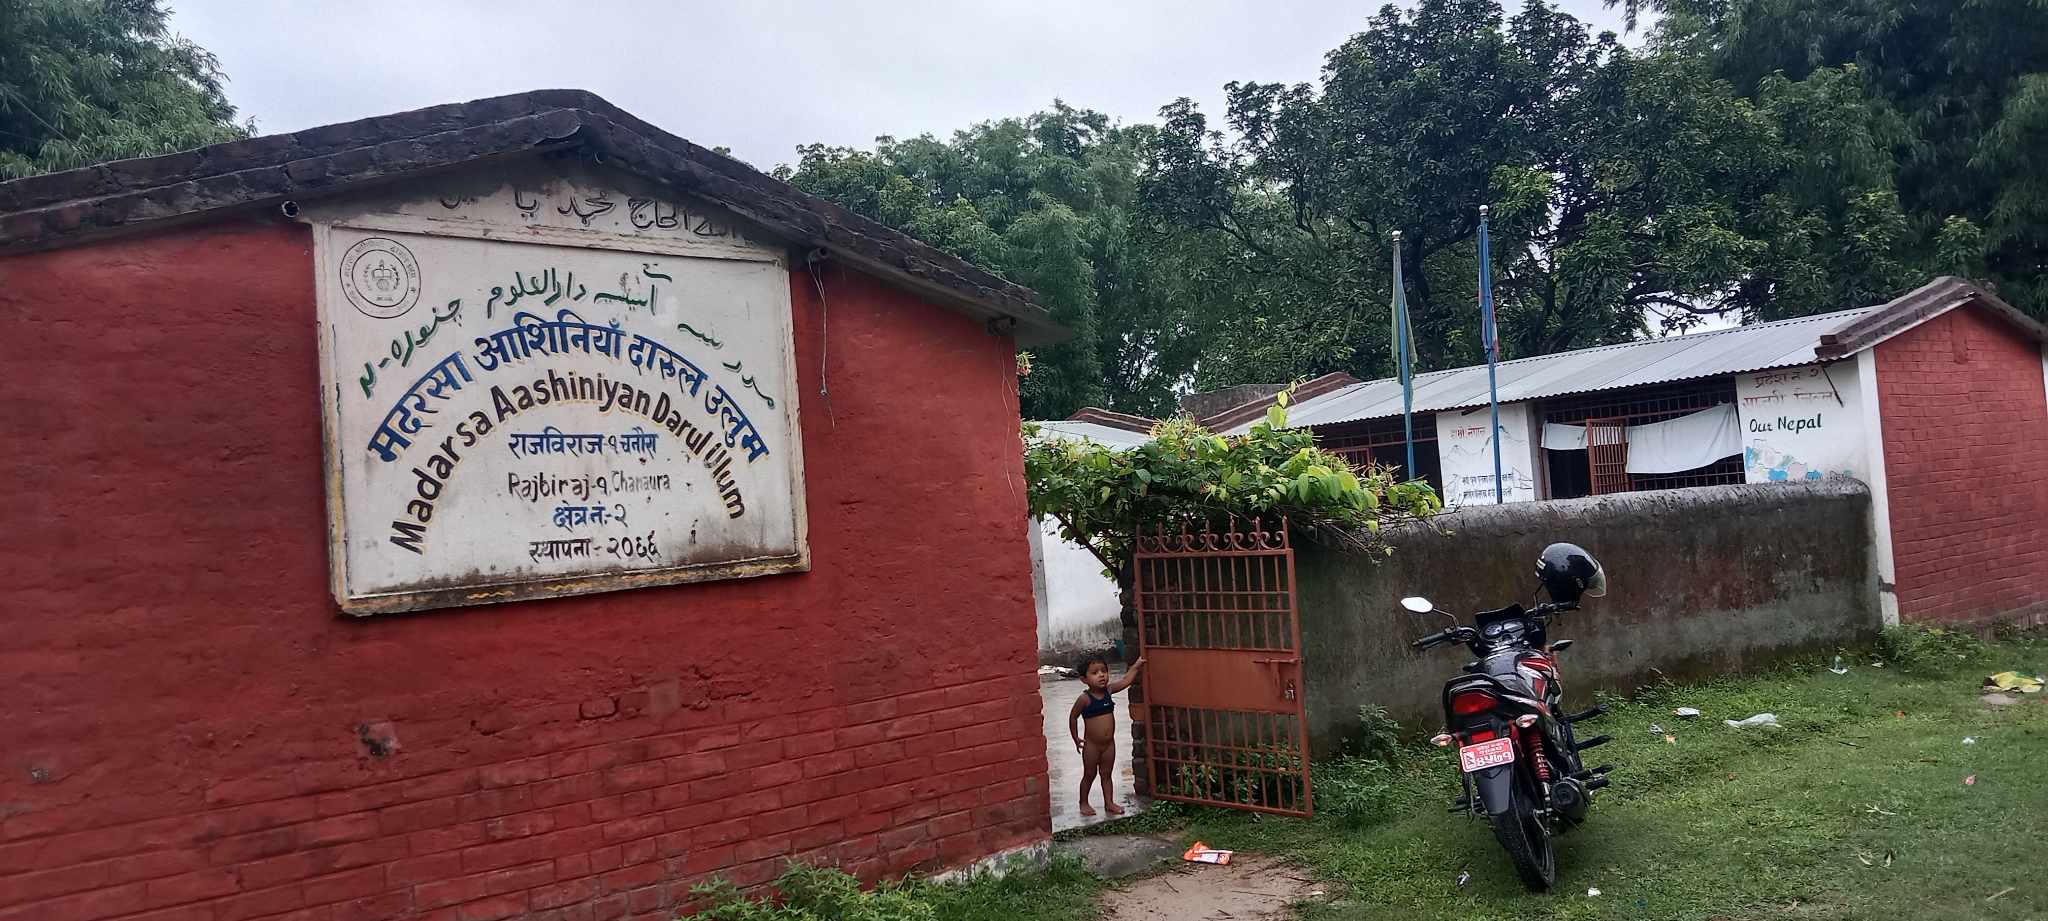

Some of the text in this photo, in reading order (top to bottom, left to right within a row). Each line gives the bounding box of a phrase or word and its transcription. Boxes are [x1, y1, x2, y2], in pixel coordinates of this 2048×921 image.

[367, 351, 474, 462] मदरसा
[490, 368, 651, 424] Aashiniyan
[651, 391, 715, 456] Darul
[703, 441, 745, 520] Ulum
[1749, 412, 1822, 434] Our Nepal
